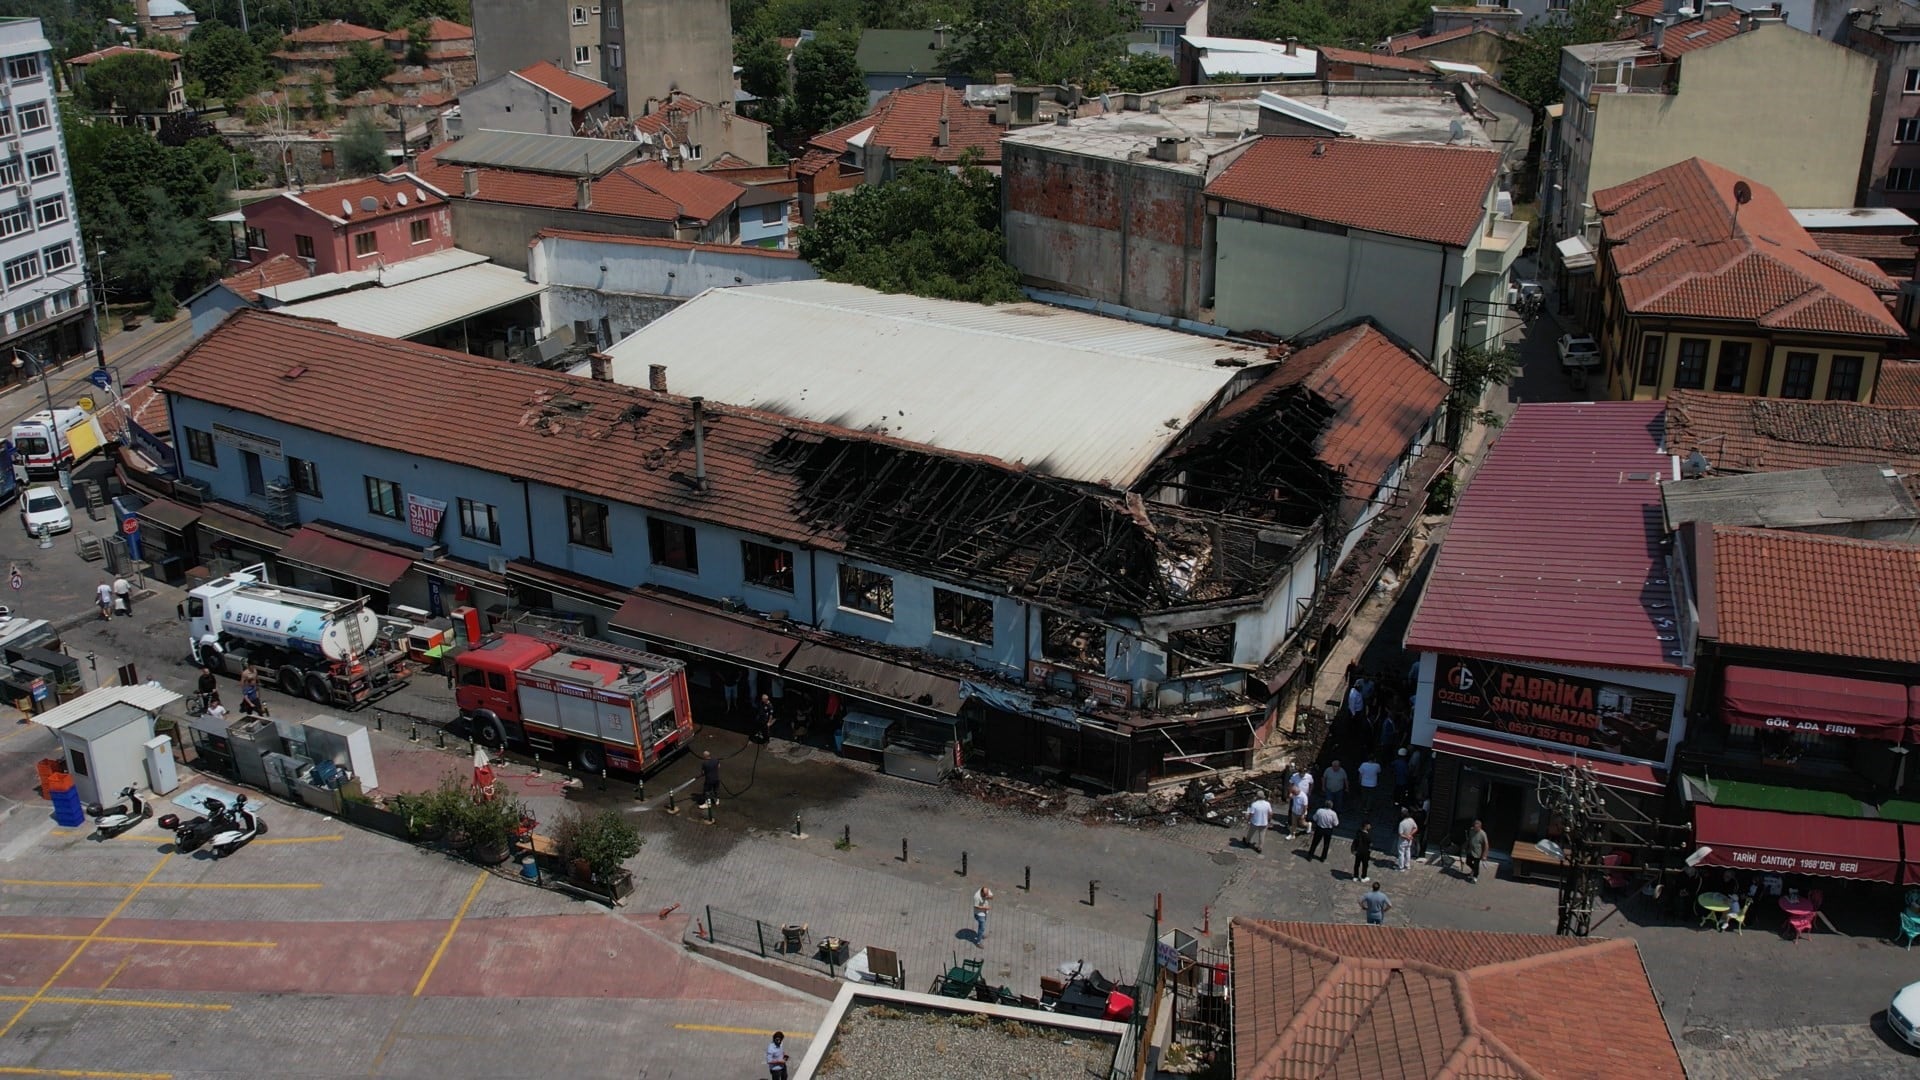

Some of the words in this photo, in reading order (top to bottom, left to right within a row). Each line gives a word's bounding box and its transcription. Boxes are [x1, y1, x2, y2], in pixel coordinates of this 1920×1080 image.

[236, 612, 268, 629] BURSA
[1438, 689, 1480, 706] ÖZGÜR
[1499, 671, 1594, 710] FABRİKA
[1492, 696, 1529, 721] SATIŞ
[1531, 703, 1601, 730] MAĞAZASI
[1766, 717, 1789, 728] GÖK
[1796, 722, 1819, 731] ADA
[1825, 724, 1856, 735] FIRIN
[1732, 851, 1757, 863] TARİHİ
[1761, 855, 1796, 868] CANTIKÇI
[1840, 861, 1858, 873] BERİ
